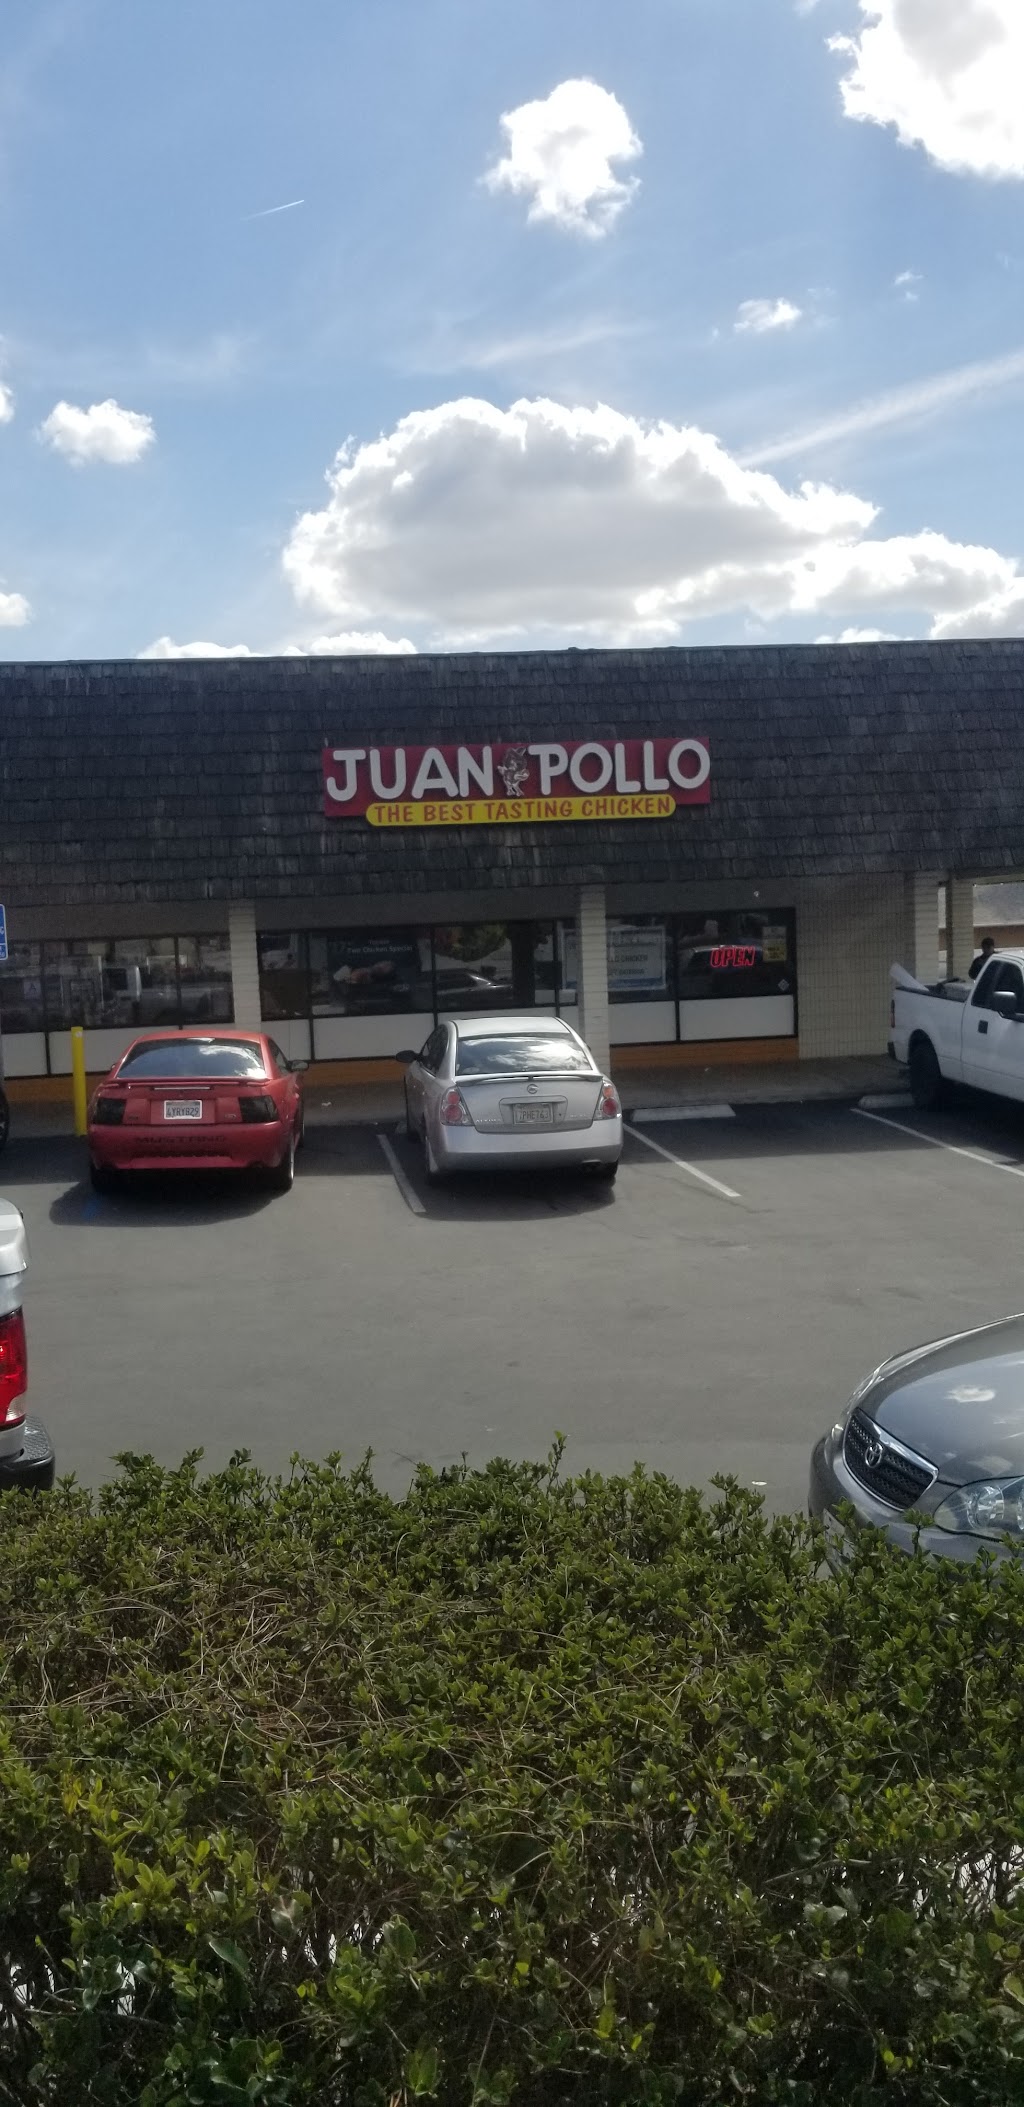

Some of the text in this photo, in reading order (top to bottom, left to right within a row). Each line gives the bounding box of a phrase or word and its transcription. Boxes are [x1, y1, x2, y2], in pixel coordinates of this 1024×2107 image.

[326, 739, 711, 802] JUAN POLLO
[374, 795, 671, 823] THE BEST TASTING CHICKEN
[710, 945, 756, 968] OPEN
